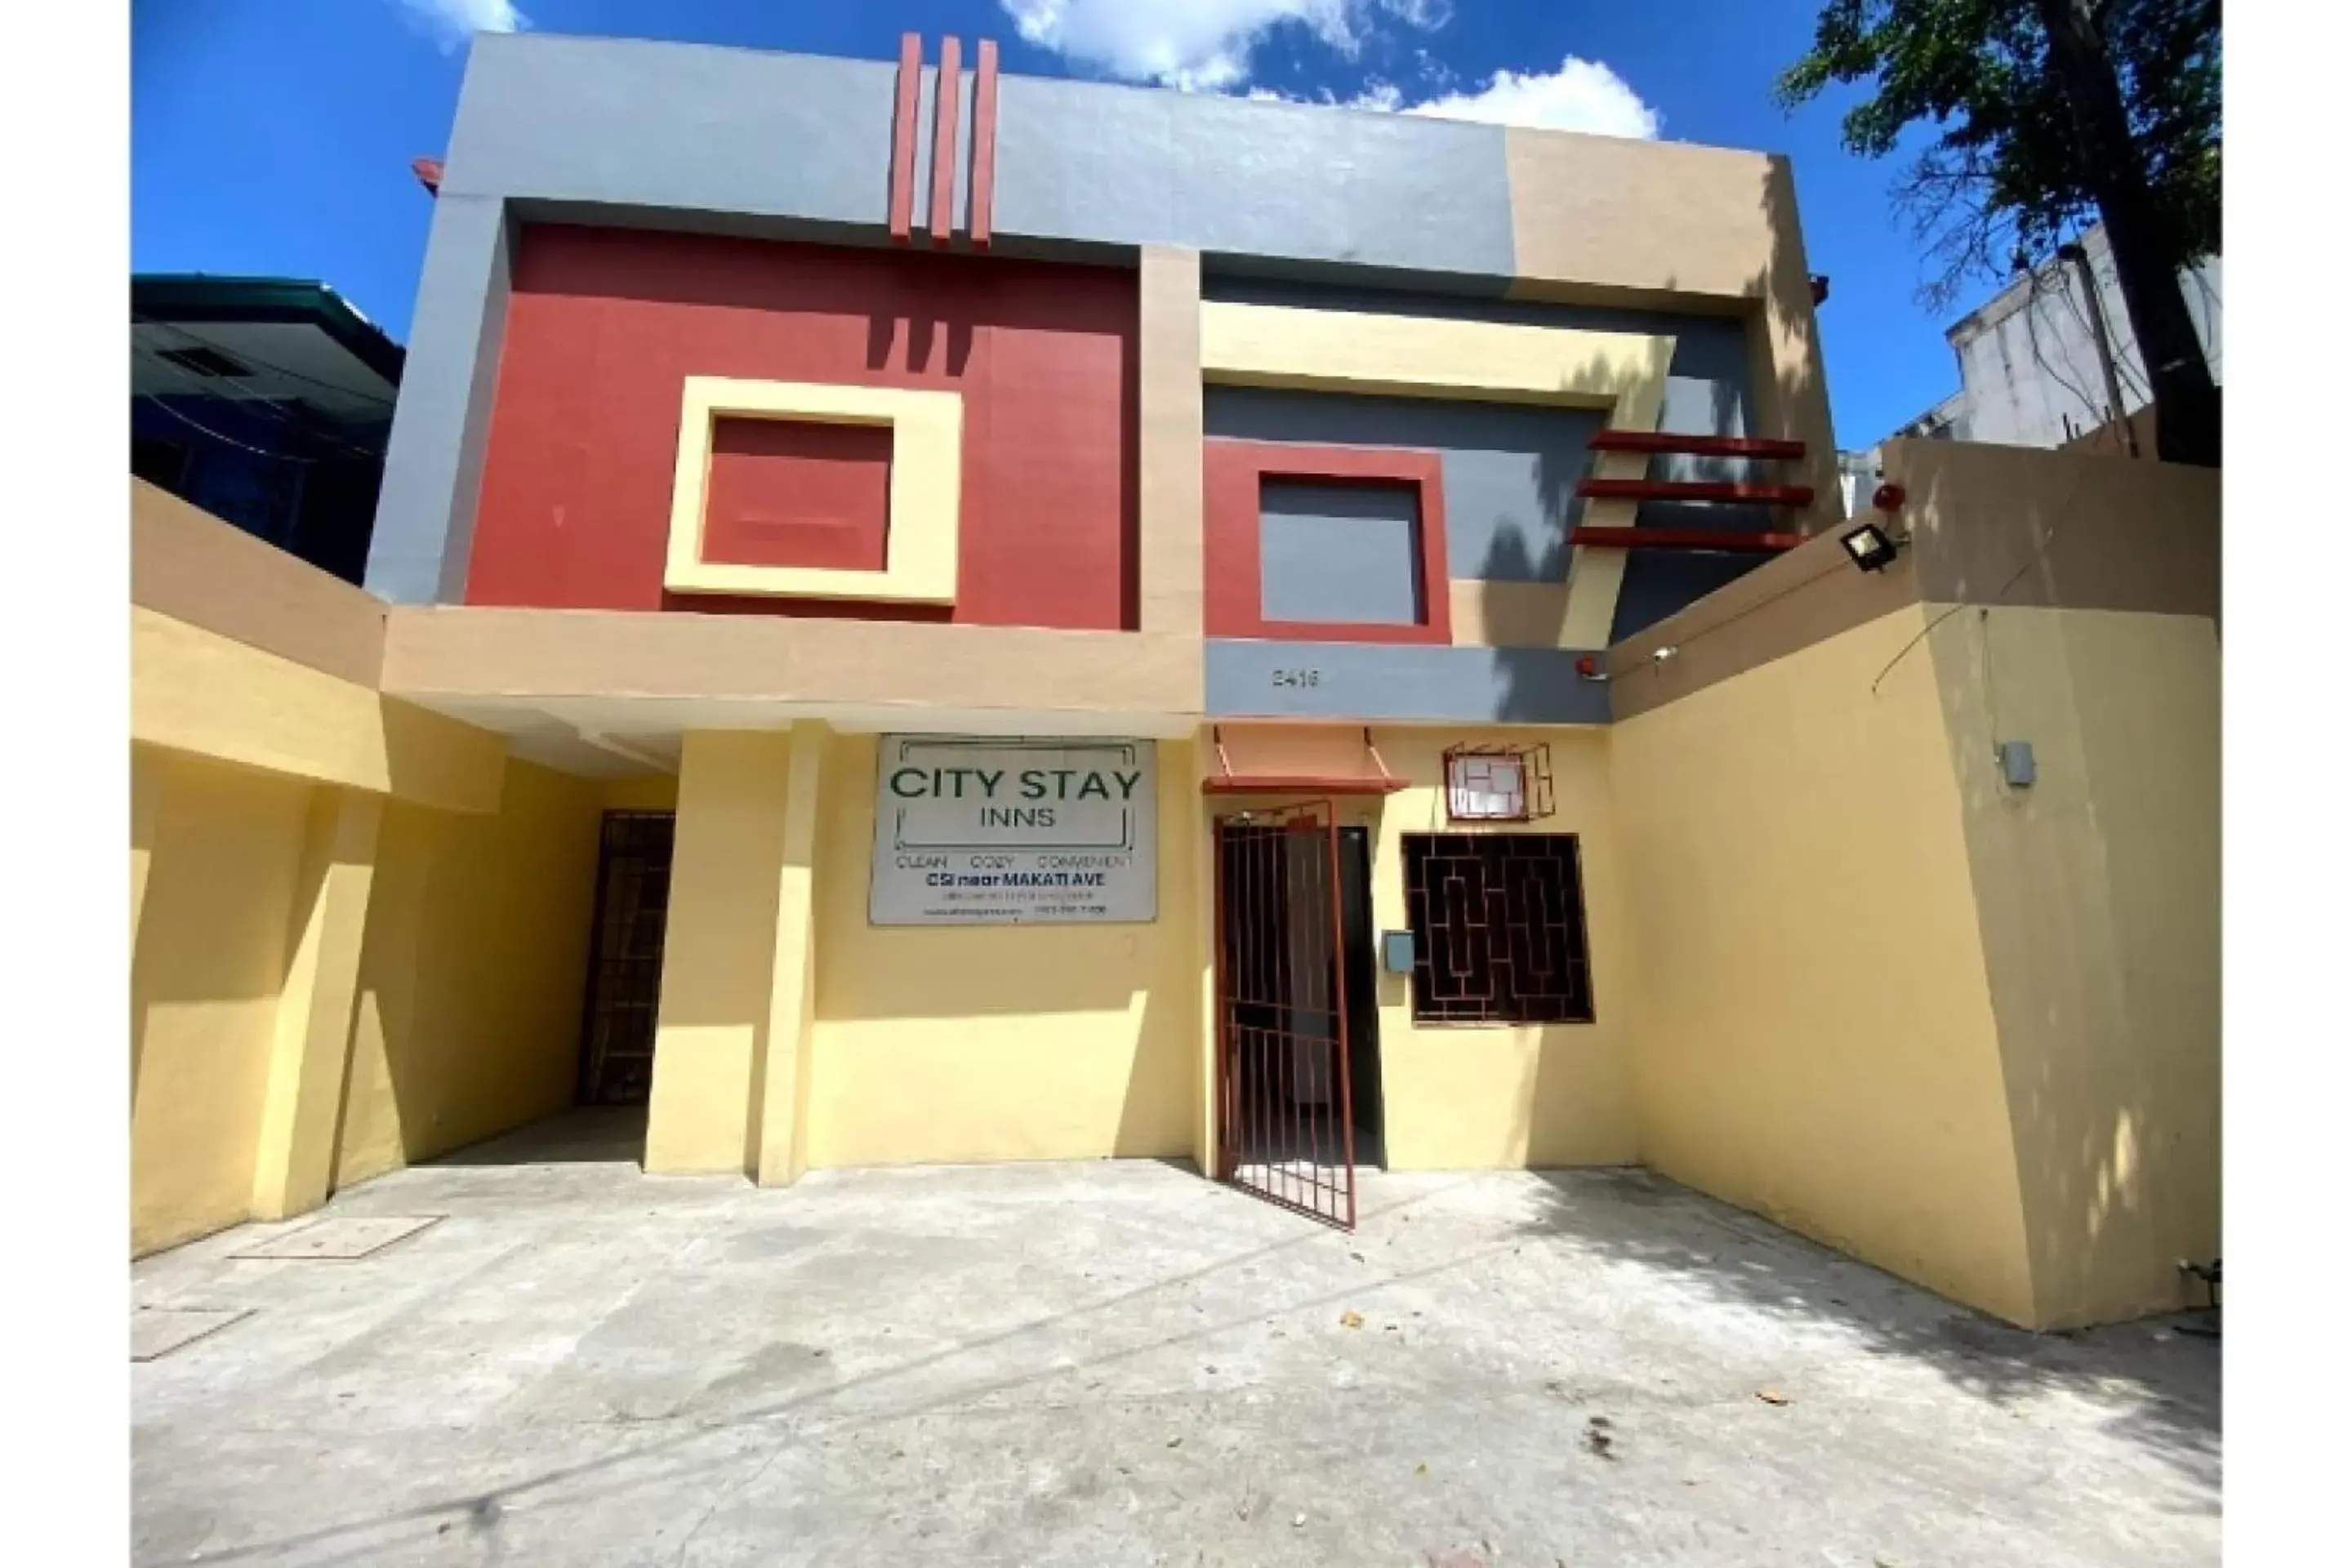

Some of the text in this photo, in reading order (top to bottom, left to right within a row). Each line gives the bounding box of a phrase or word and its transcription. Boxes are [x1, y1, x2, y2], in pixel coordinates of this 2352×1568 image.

[890, 768, 1141, 800] CITY STAY
[980, 807, 1056, 828] INNS
[896, 856, 948, 869] CLEAN
[970, 856, 1015, 869] COZY
[957, 874, 1000, 887] near
[1002, 872, 1068, 887] MAKATI
[1071, 872, 1107, 887] AVE
